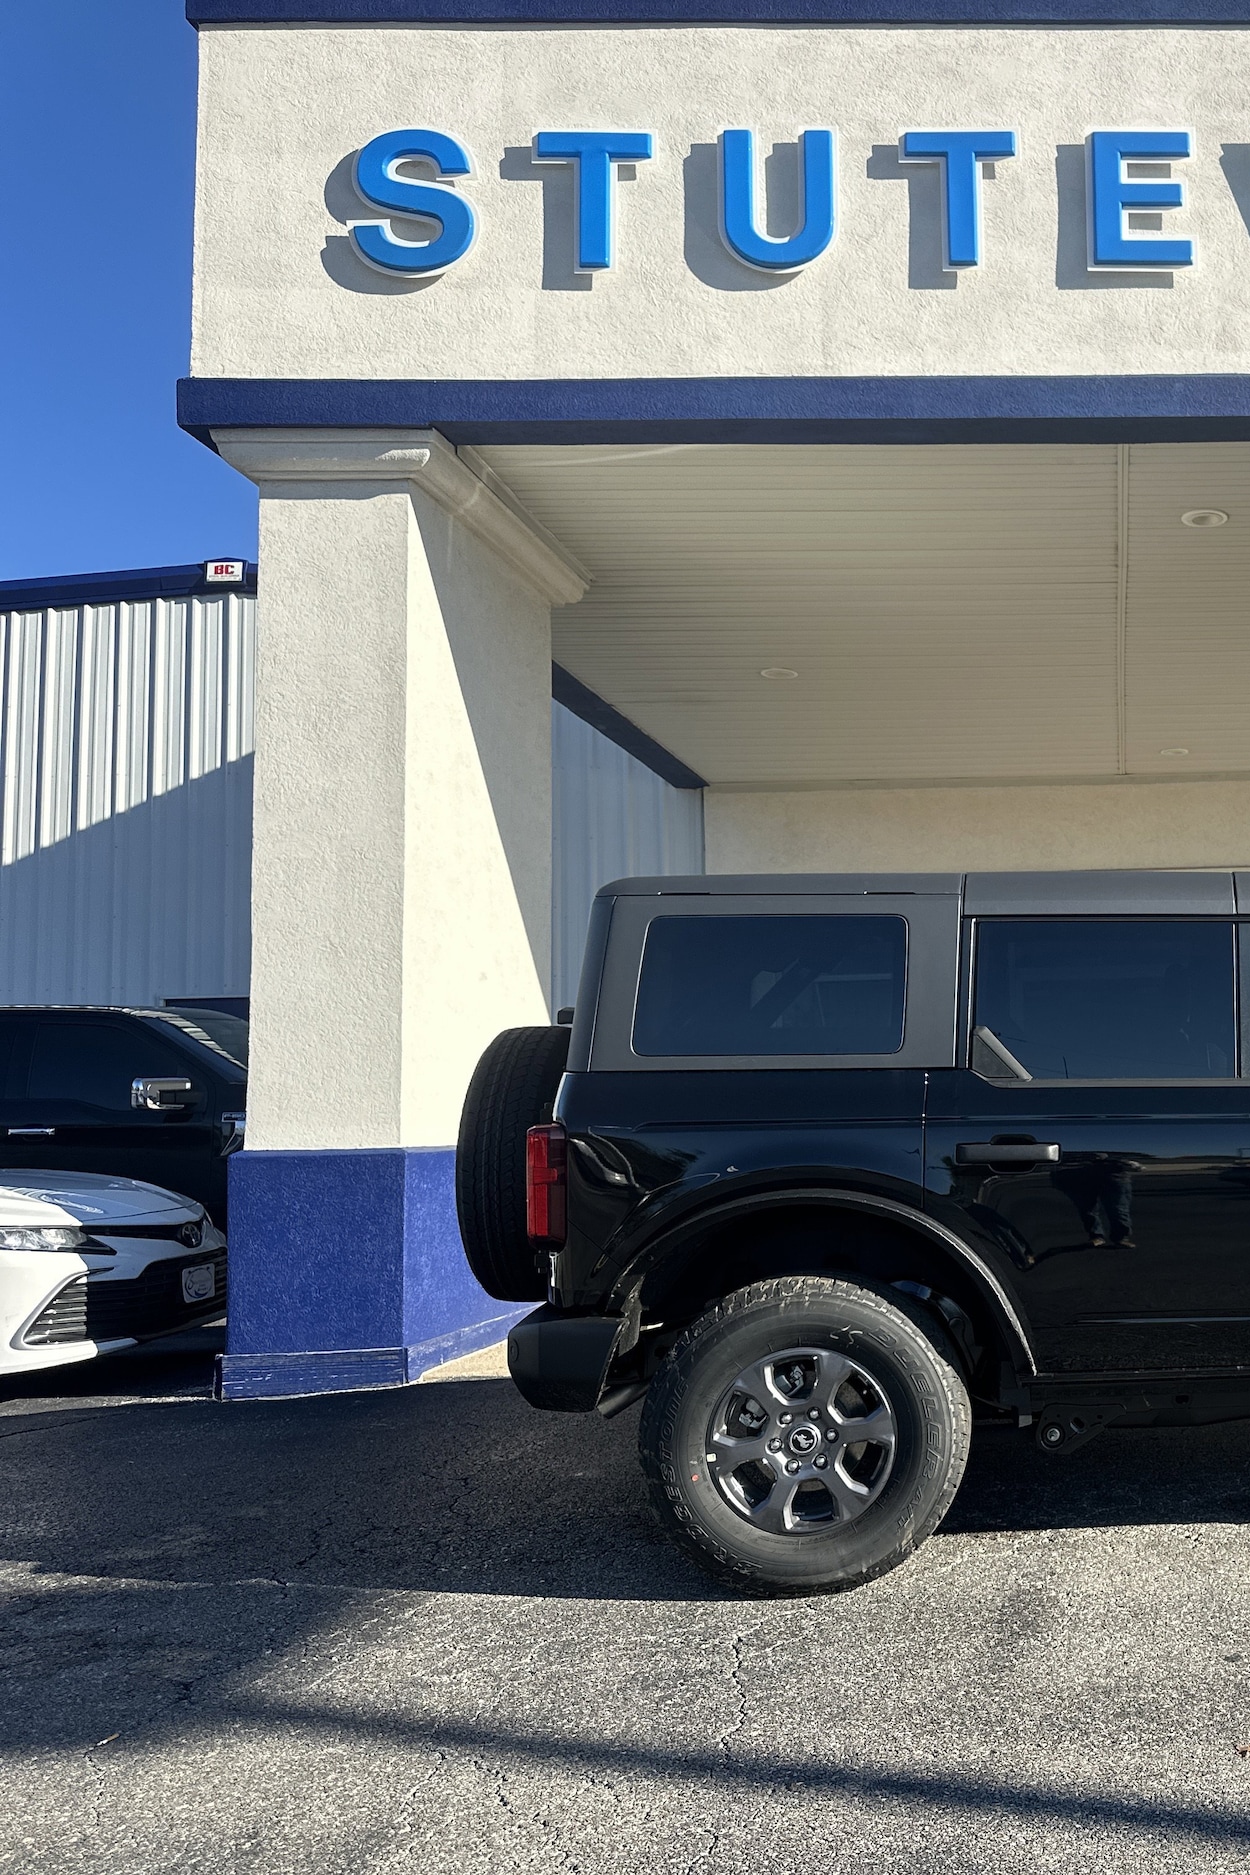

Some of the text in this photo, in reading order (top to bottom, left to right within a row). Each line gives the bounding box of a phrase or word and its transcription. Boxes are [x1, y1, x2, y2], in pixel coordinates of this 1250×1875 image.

[214, 564, 235, 575] BC
[658, 1378, 763, 1576] BRIDGESTONE
[868, 1327, 944, 1480] DUELER
